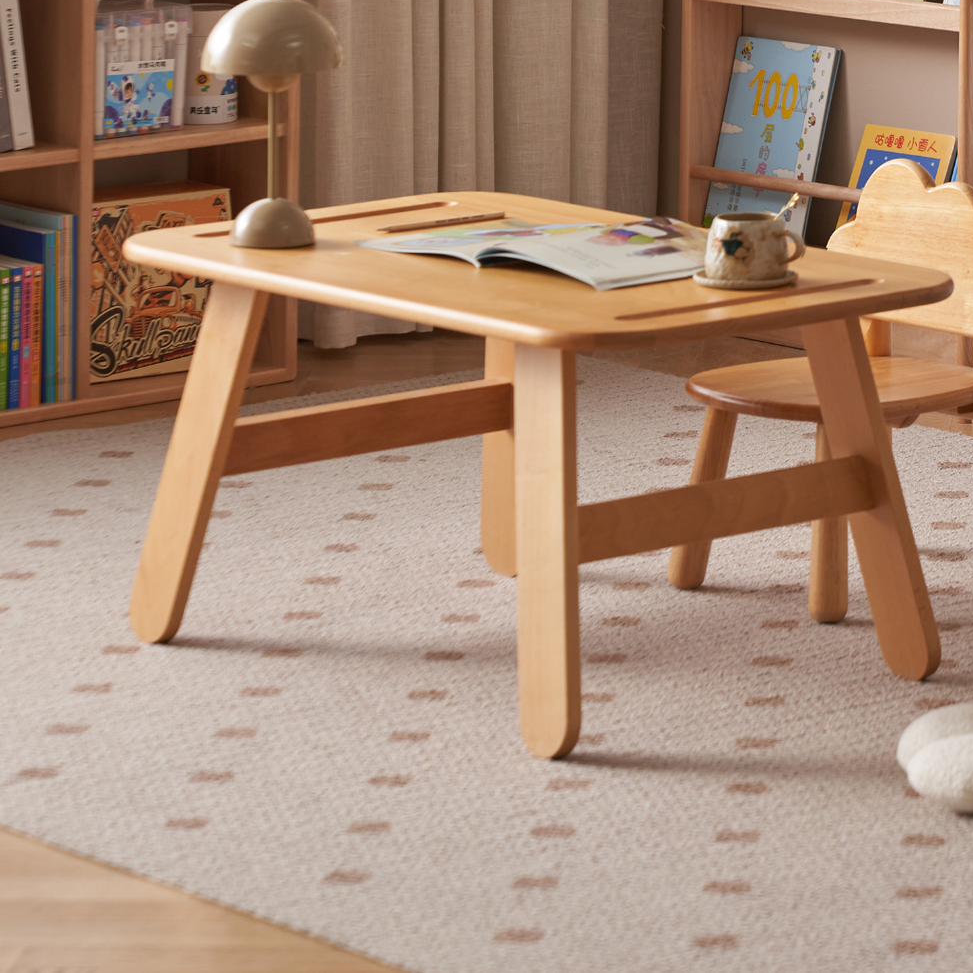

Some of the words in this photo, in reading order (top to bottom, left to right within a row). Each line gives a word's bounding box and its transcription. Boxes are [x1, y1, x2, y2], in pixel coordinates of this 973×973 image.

[749, 69, 799, 120] 100
[875, 133, 904, 149] 咕噜噜
[907, 137, 937, 153] 小雪人
